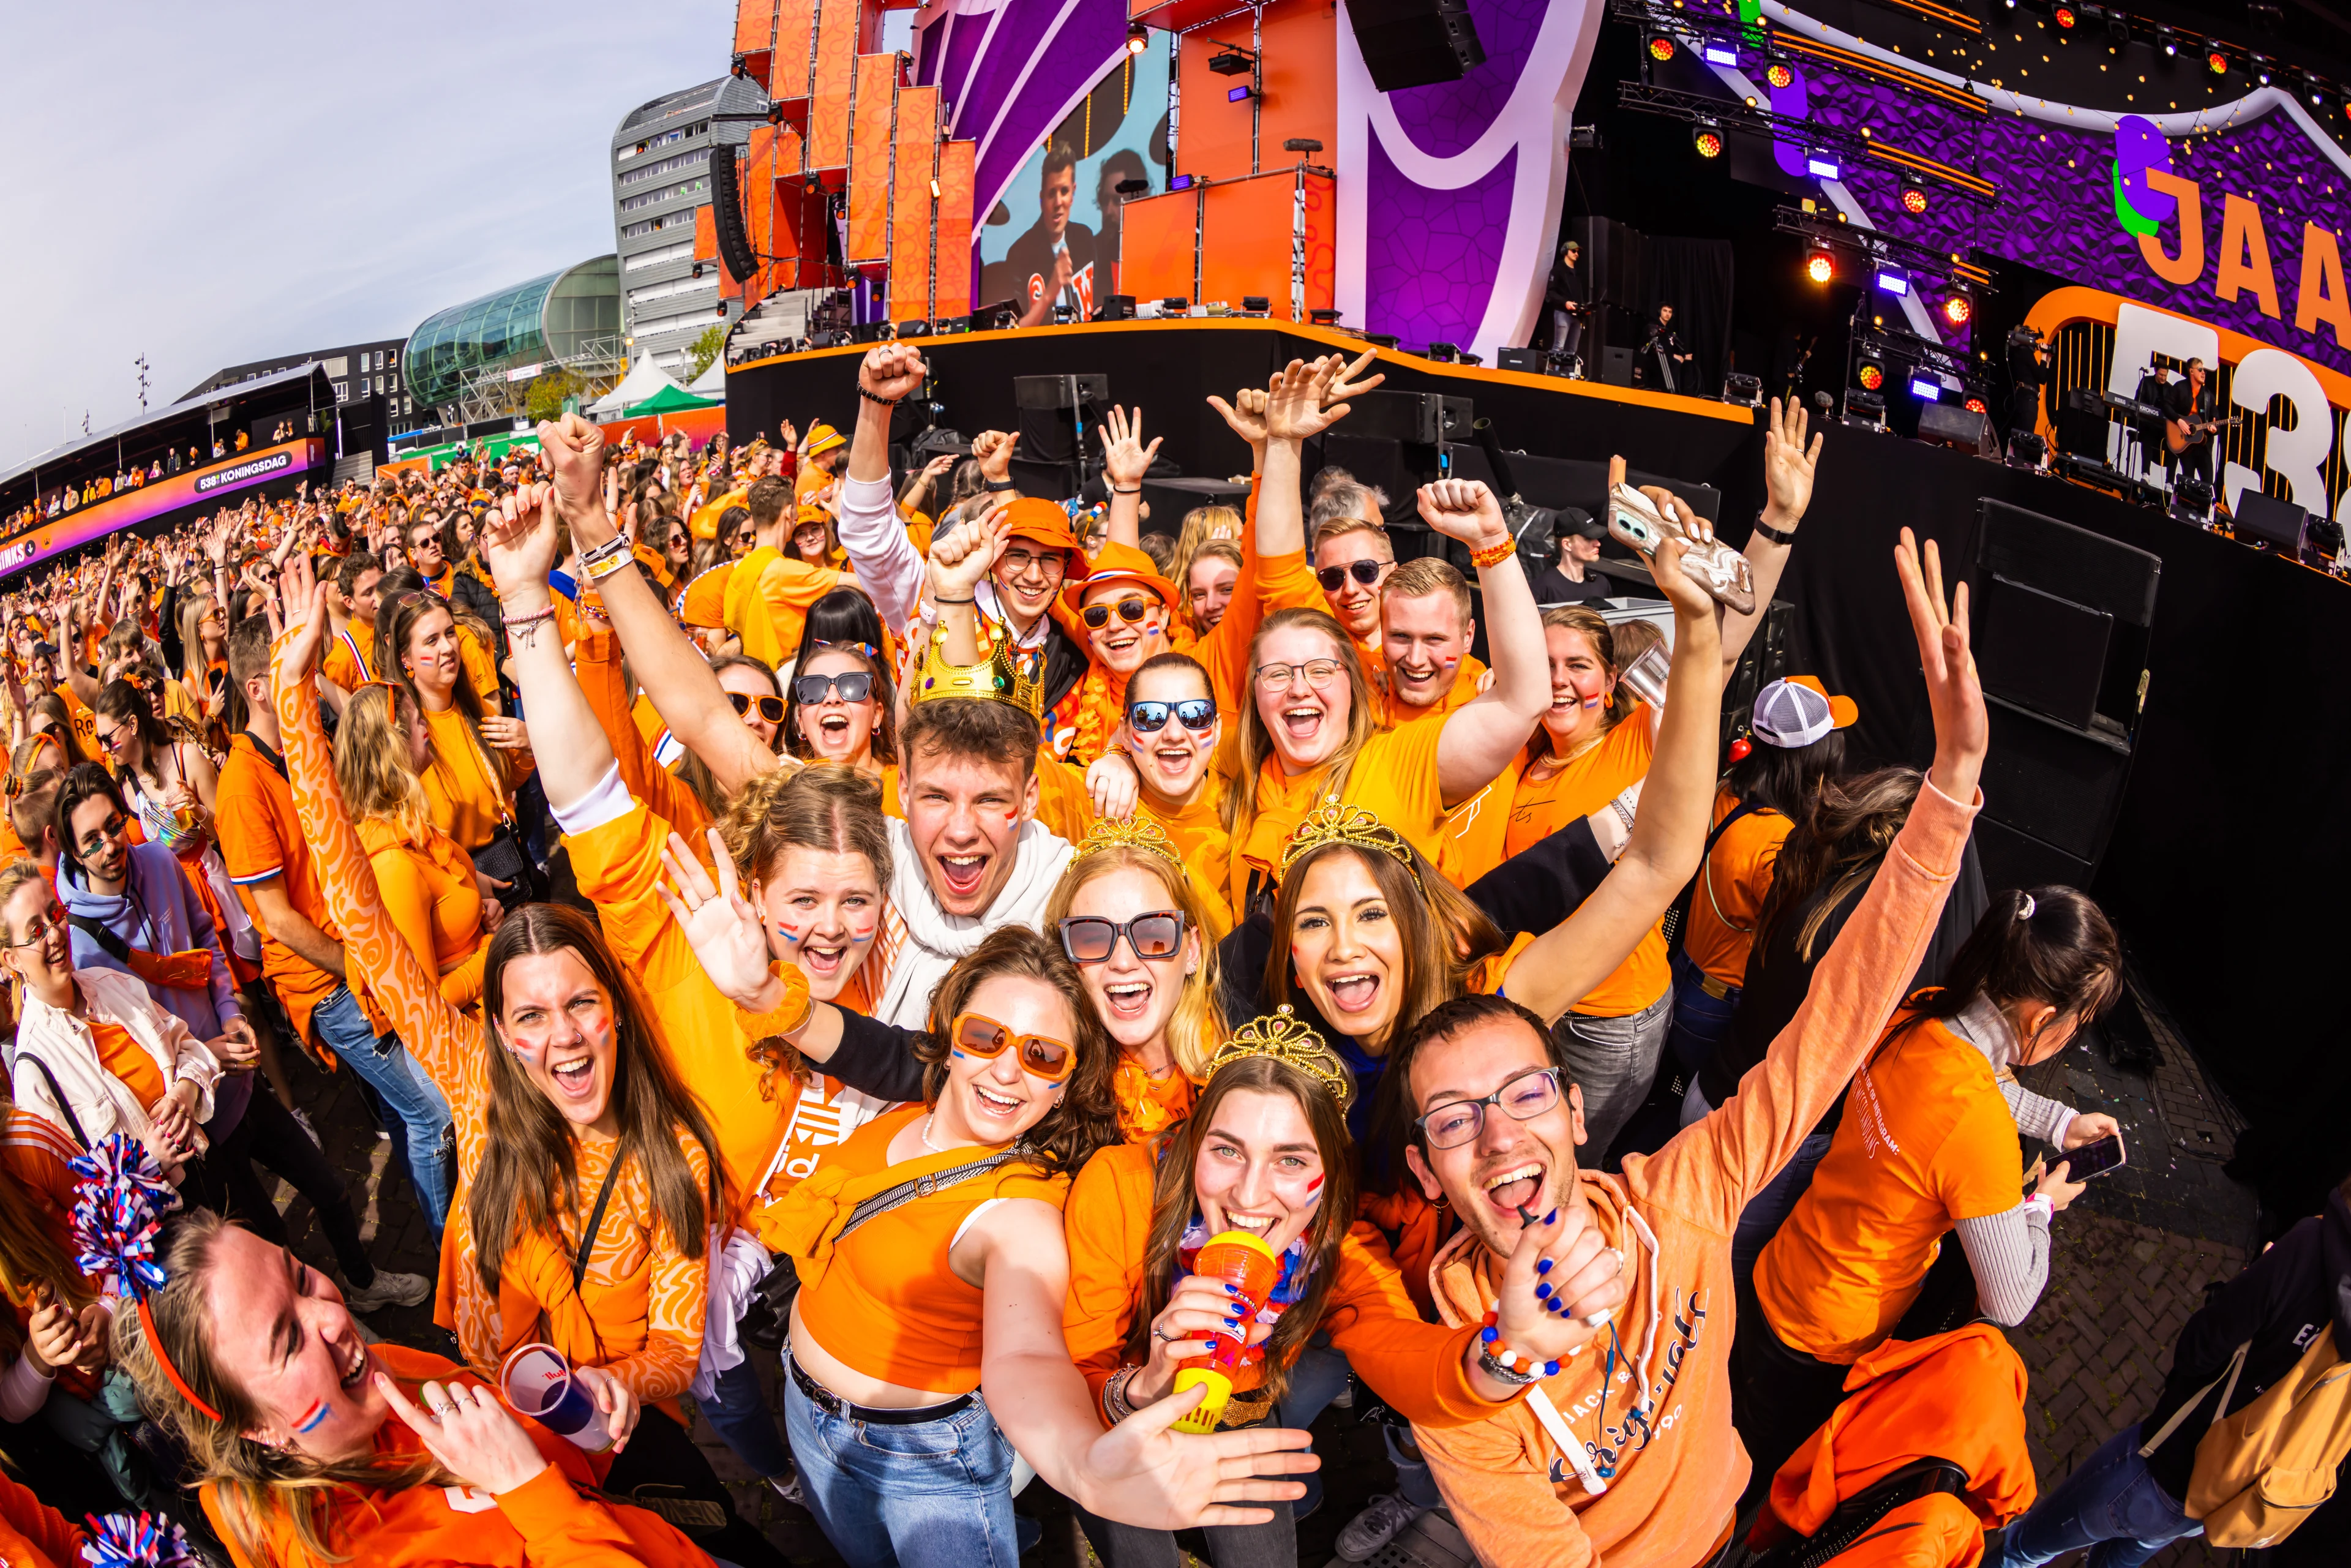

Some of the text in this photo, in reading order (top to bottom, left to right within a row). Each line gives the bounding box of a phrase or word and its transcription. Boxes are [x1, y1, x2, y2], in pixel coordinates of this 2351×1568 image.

[2139, 405, 2159, 416] KRONOS
[200, 455, 287, 490] 538 KONINGSDAG
[0, 543, 24, 571] INKS
[1869, 1089, 1877, 1101] OP
[1873, 1099, 1900, 1156] INSTAGRAM:
[1562, 1387, 1616, 1424] JACK
